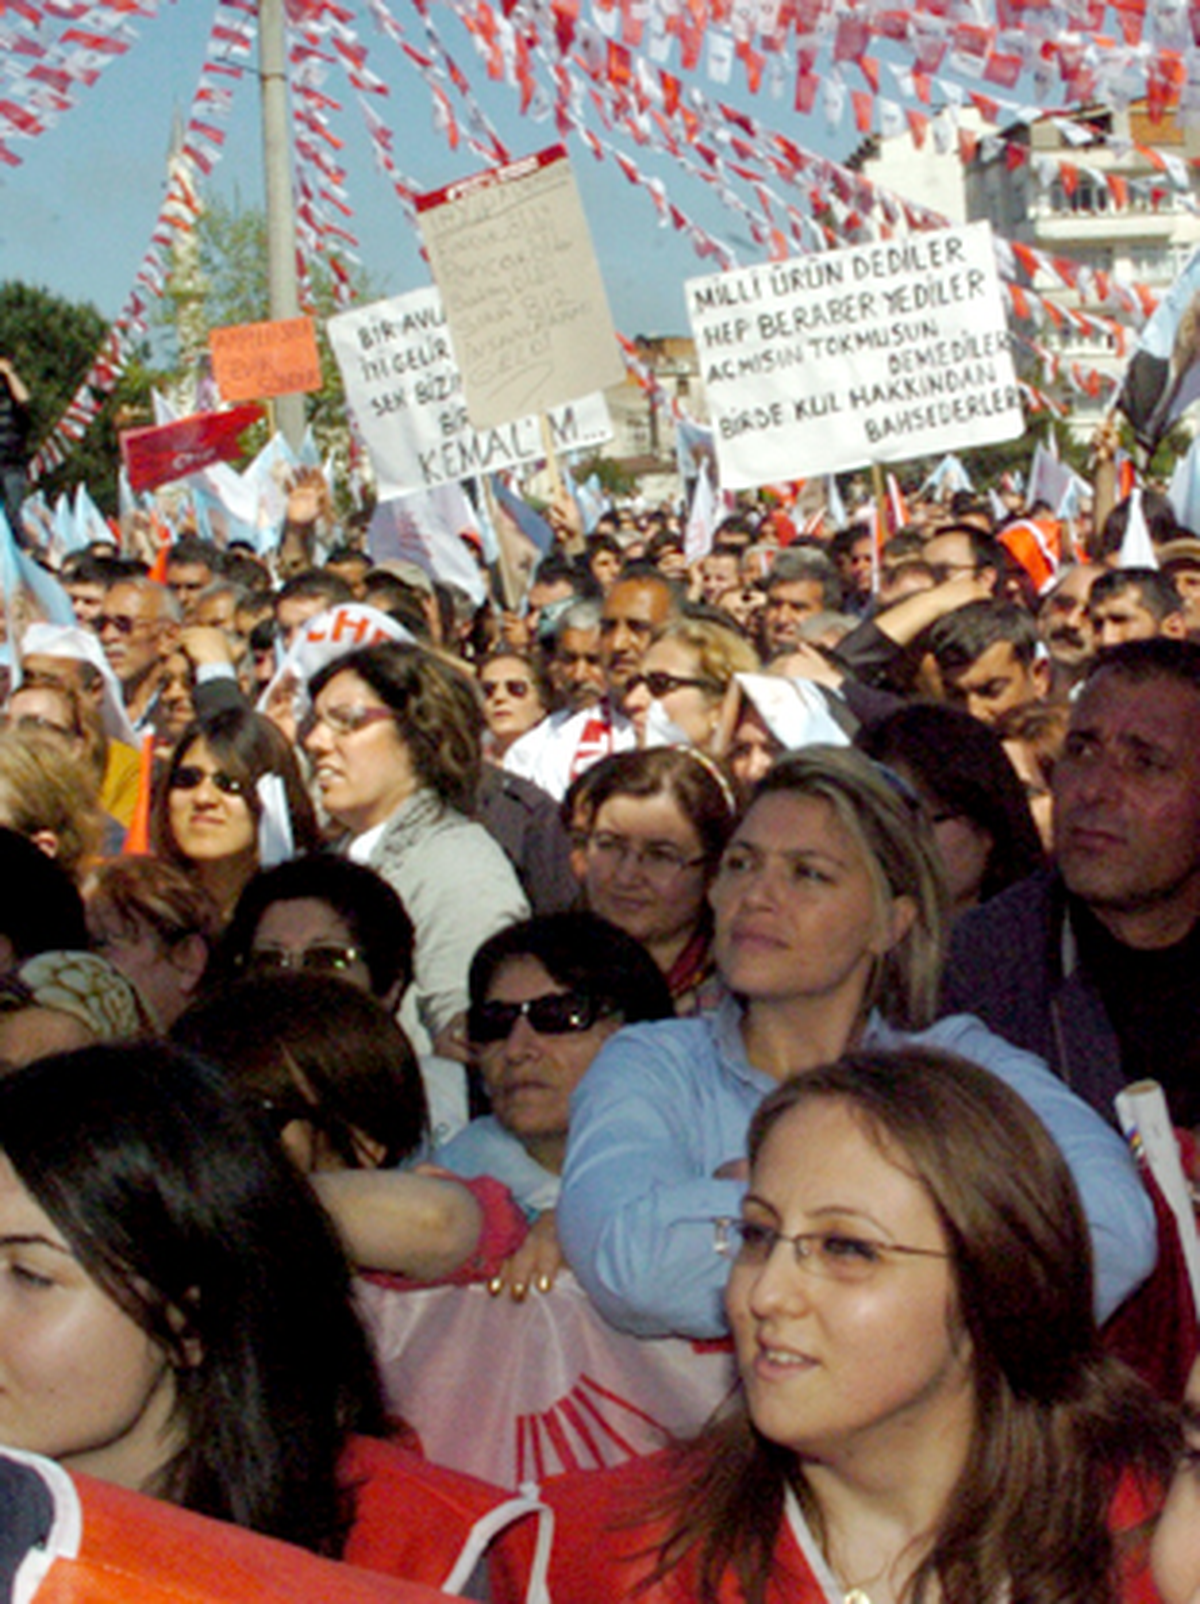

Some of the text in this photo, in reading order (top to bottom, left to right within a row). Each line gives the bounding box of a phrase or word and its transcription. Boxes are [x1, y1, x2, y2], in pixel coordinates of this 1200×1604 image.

[770, 256, 844, 298] ÜRÜN
[703, 268, 986, 348] HEP BERABER YEDİLER
[809, 319, 940, 359] TOKMUSUN
[719, 361, 997, 441] BİRDE KUL HAKKINDAN
[864, 385, 1020, 443] BAHSEDERLER
